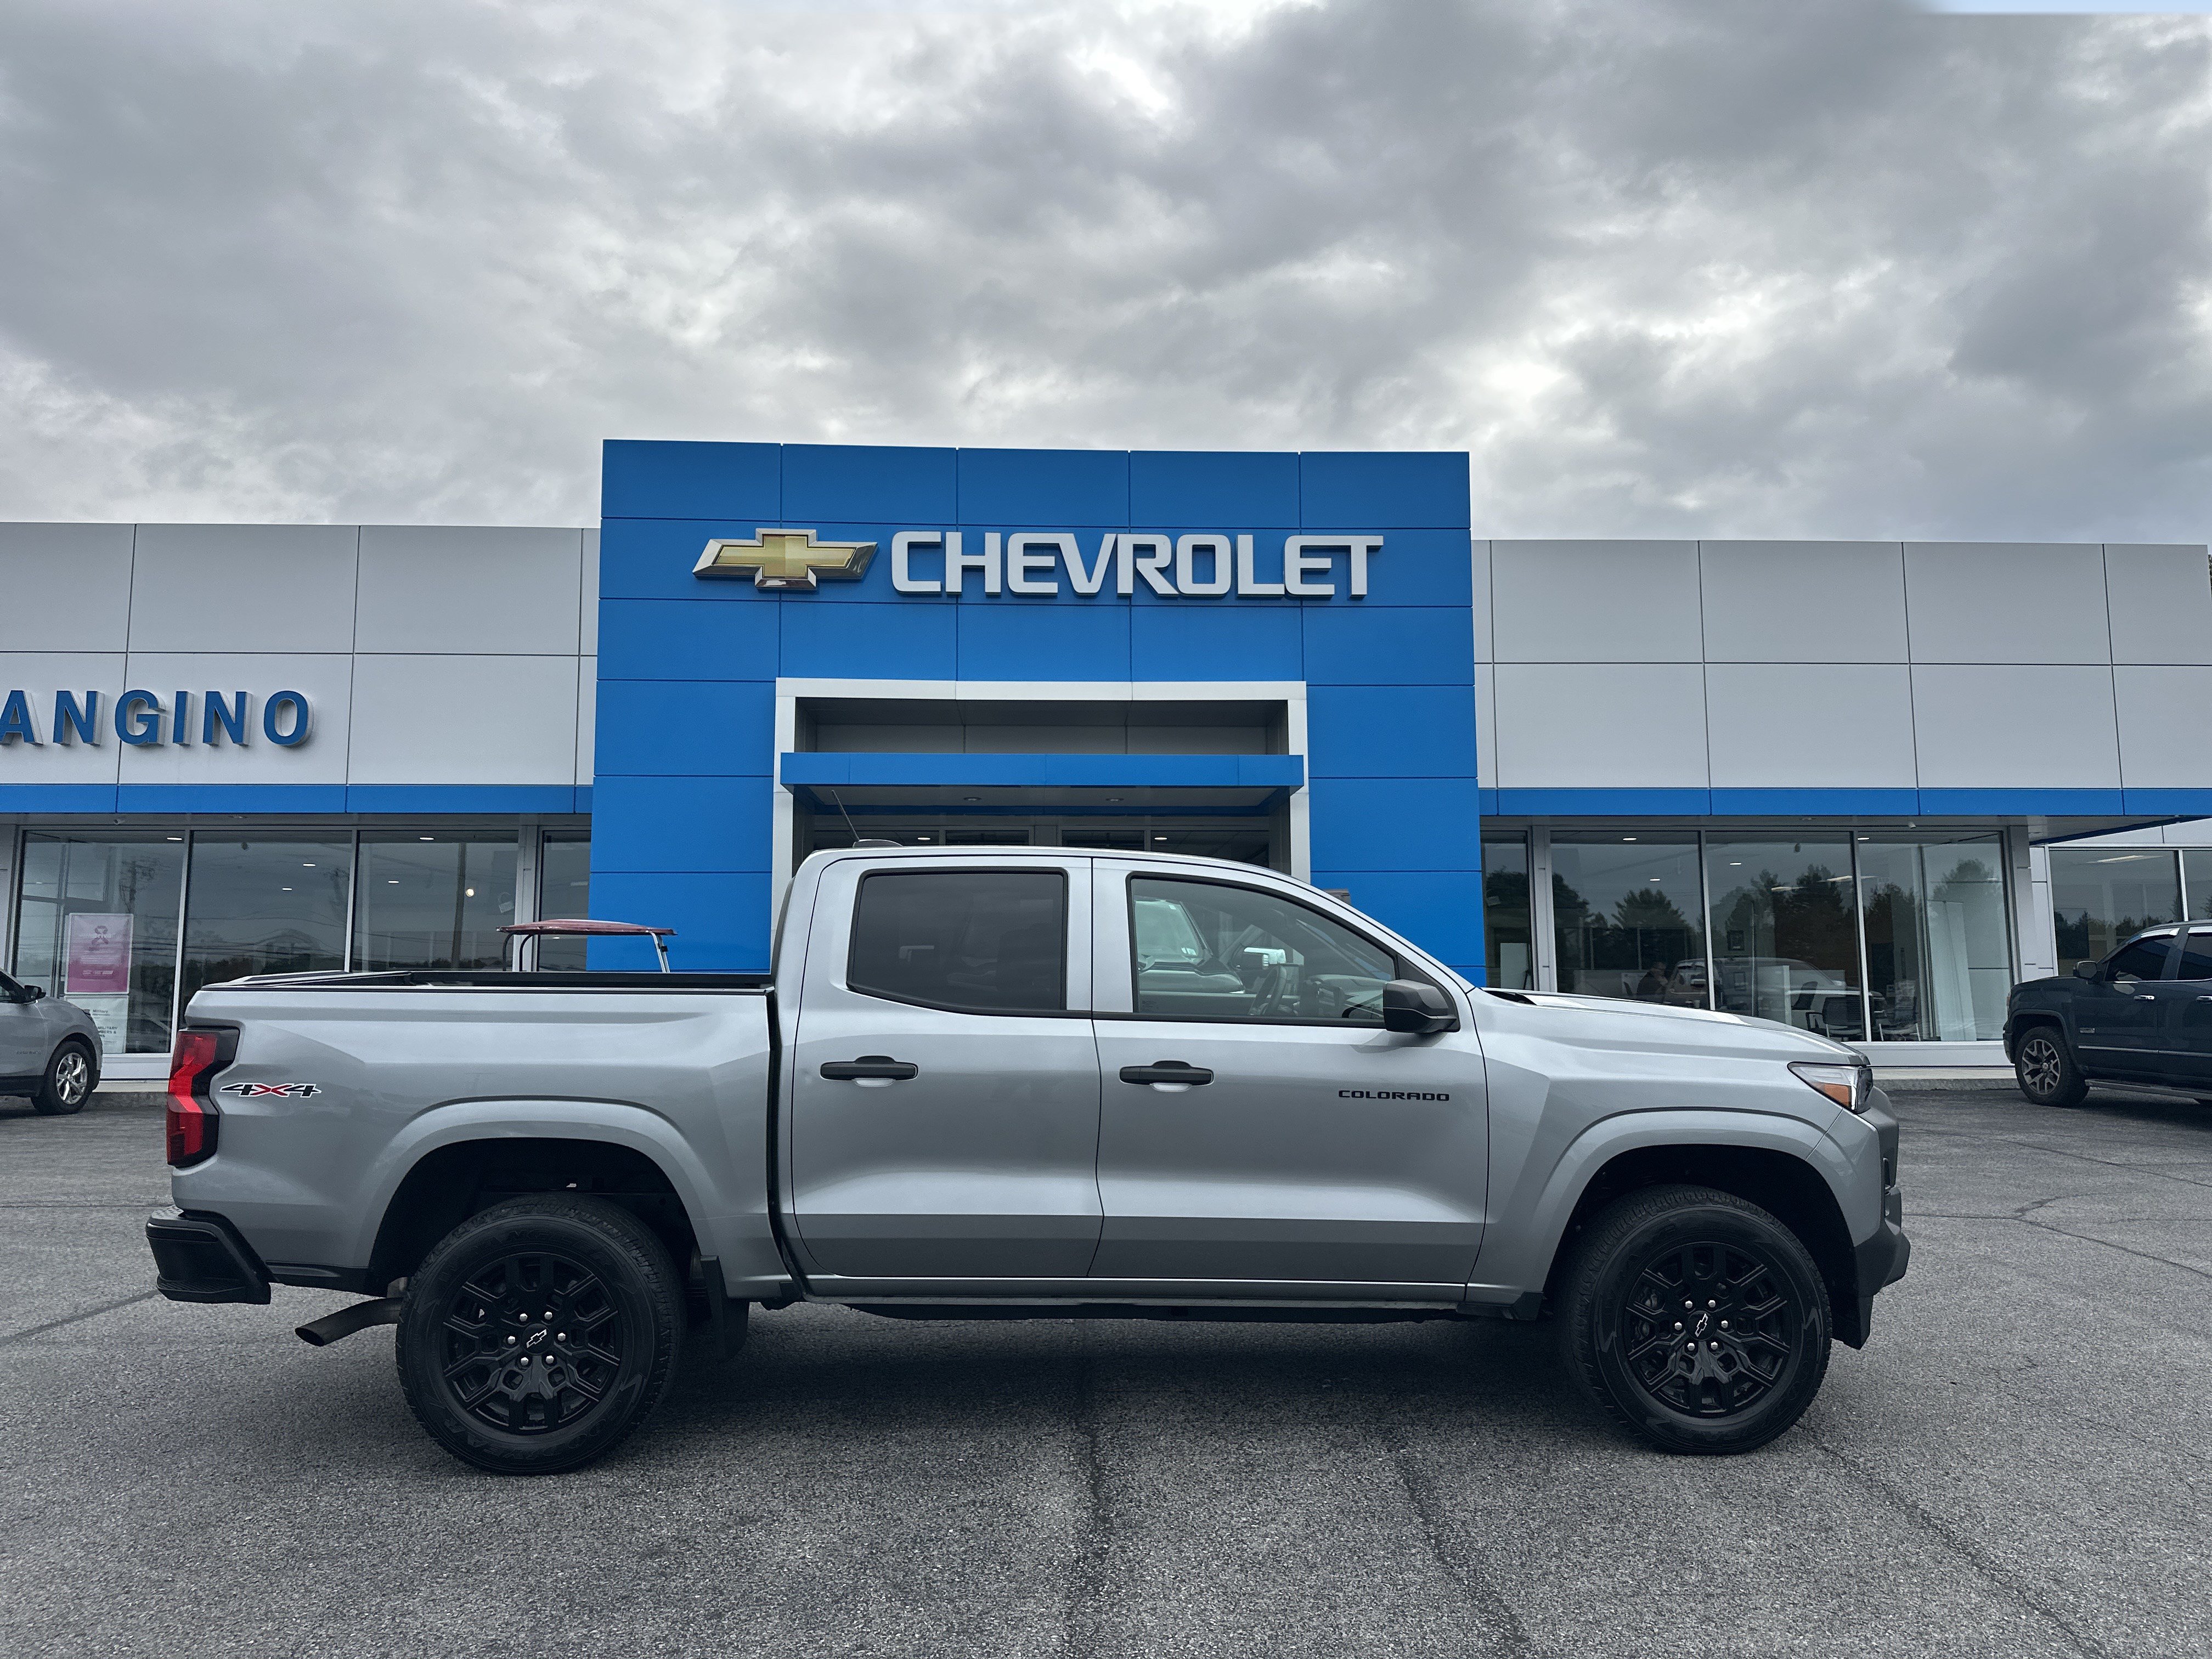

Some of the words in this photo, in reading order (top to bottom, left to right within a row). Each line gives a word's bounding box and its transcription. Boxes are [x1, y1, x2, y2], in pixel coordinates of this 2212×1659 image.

[890, 531, 1384, 598] CHEVROLET
[0, 689, 313, 747] ANGINO
[1338, 1090, 1450, 1102] COLORADO
